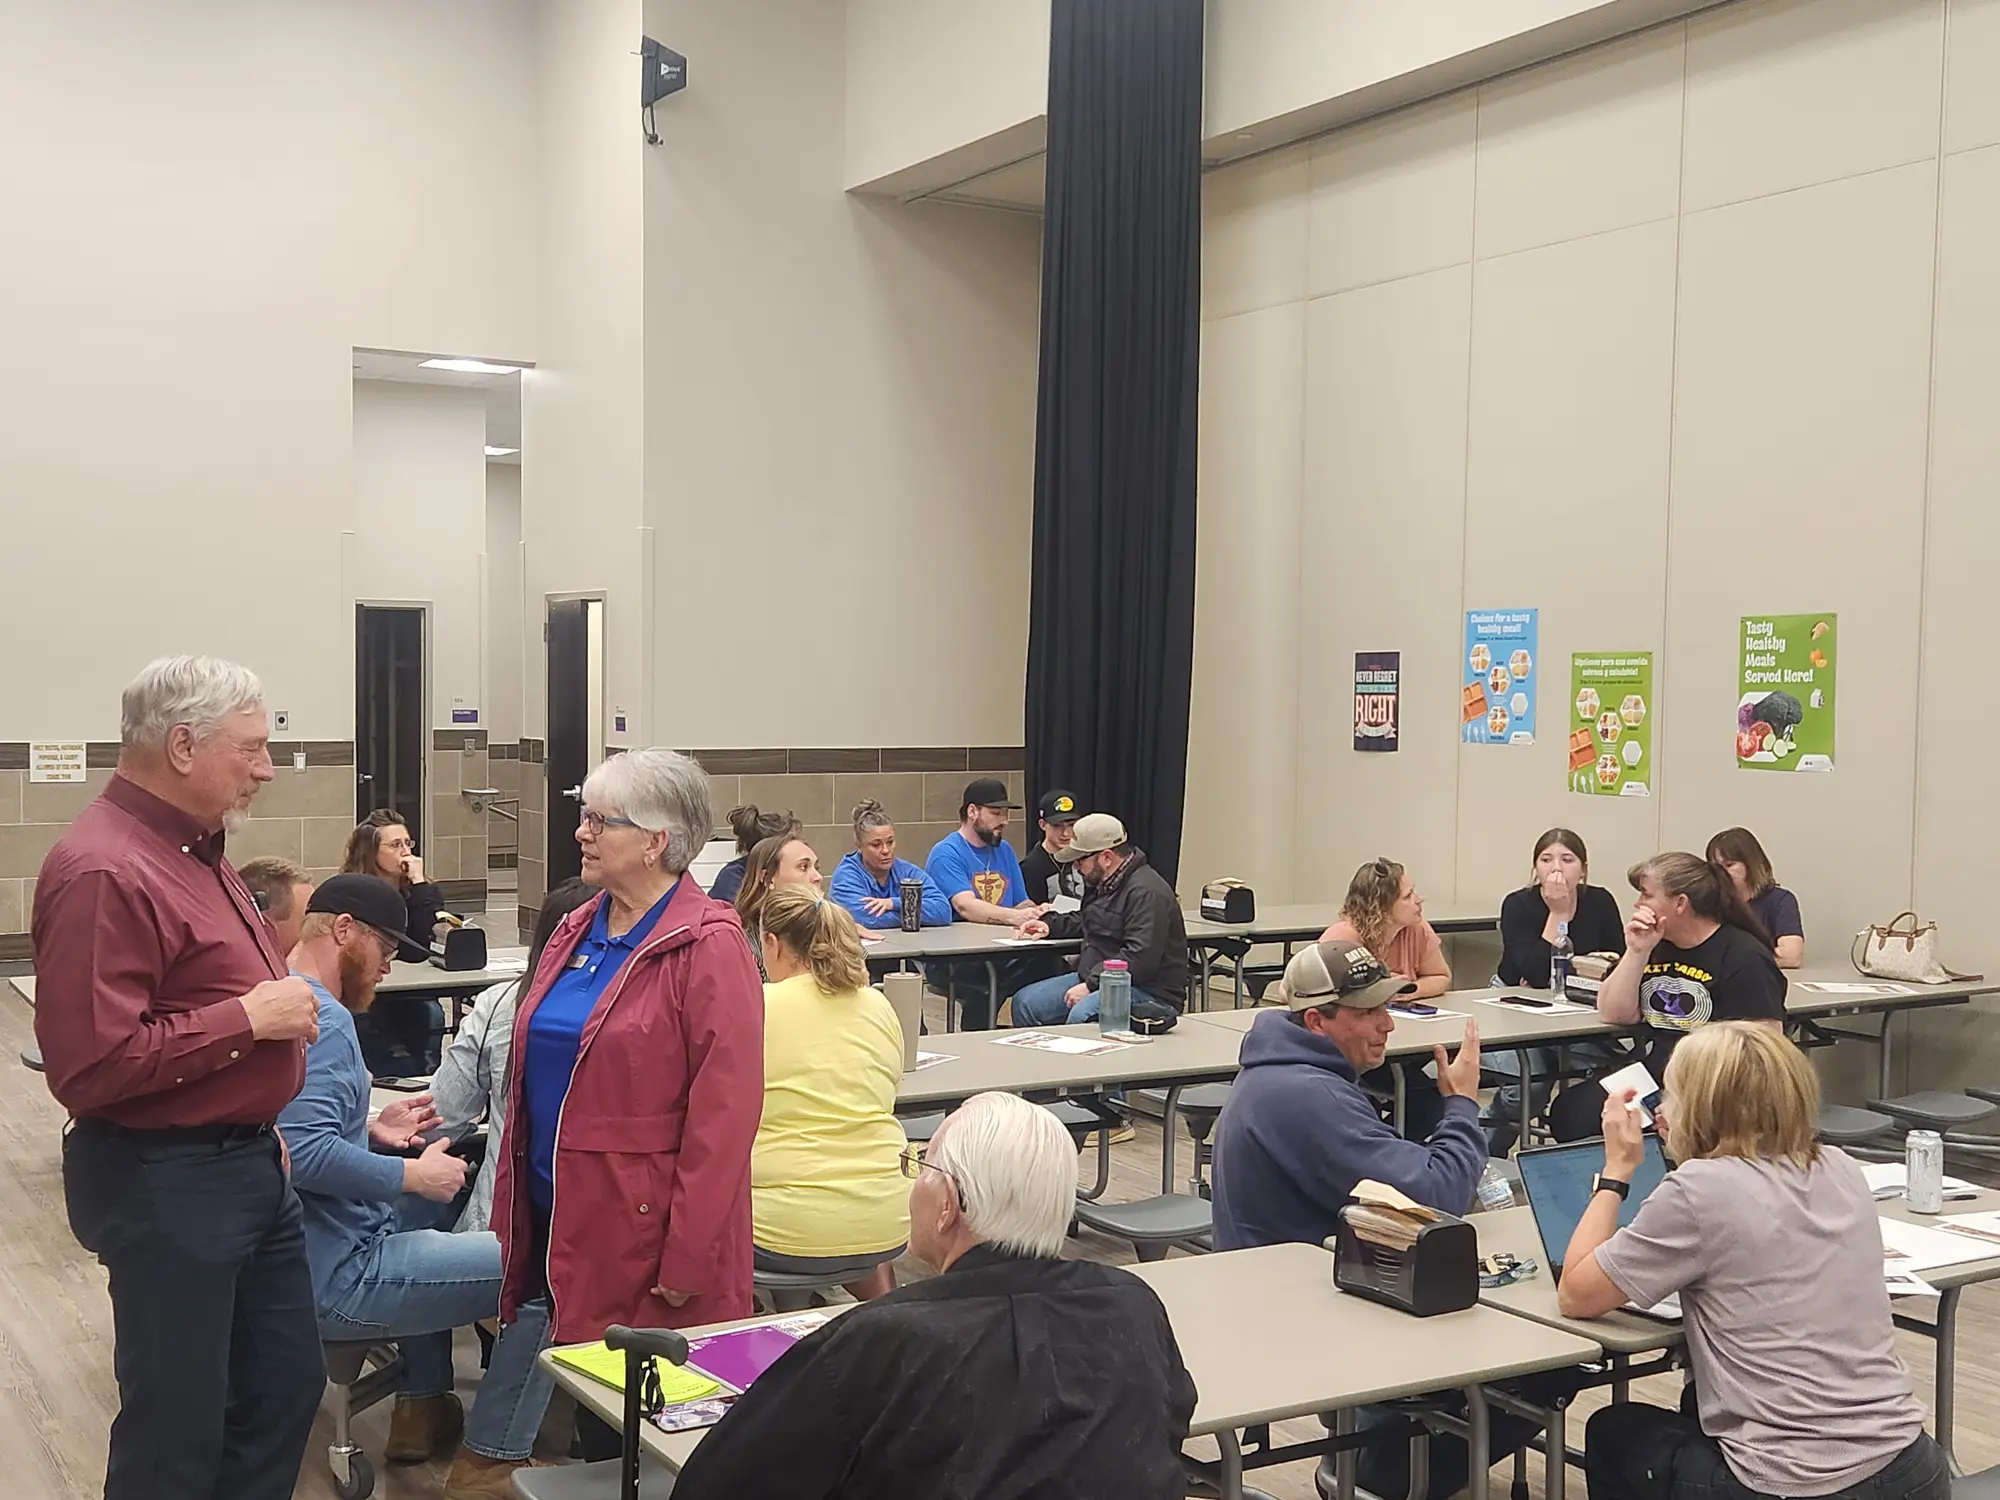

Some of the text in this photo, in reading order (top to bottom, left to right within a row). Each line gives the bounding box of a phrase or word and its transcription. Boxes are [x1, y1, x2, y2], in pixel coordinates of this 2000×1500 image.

[1745, 621, 1774, 637] Tasty
[1745, 637, 1786, 653] Healthy
[1745, 653, 1776, 668] Meals
[1356, 670, 1397, 683] NEVER REGRET
[1744, 669, 1814, 684] Served Here!
[1355, 694, 1397, 723] RIGHT
[1643, 963, 1671, 974] KIT
